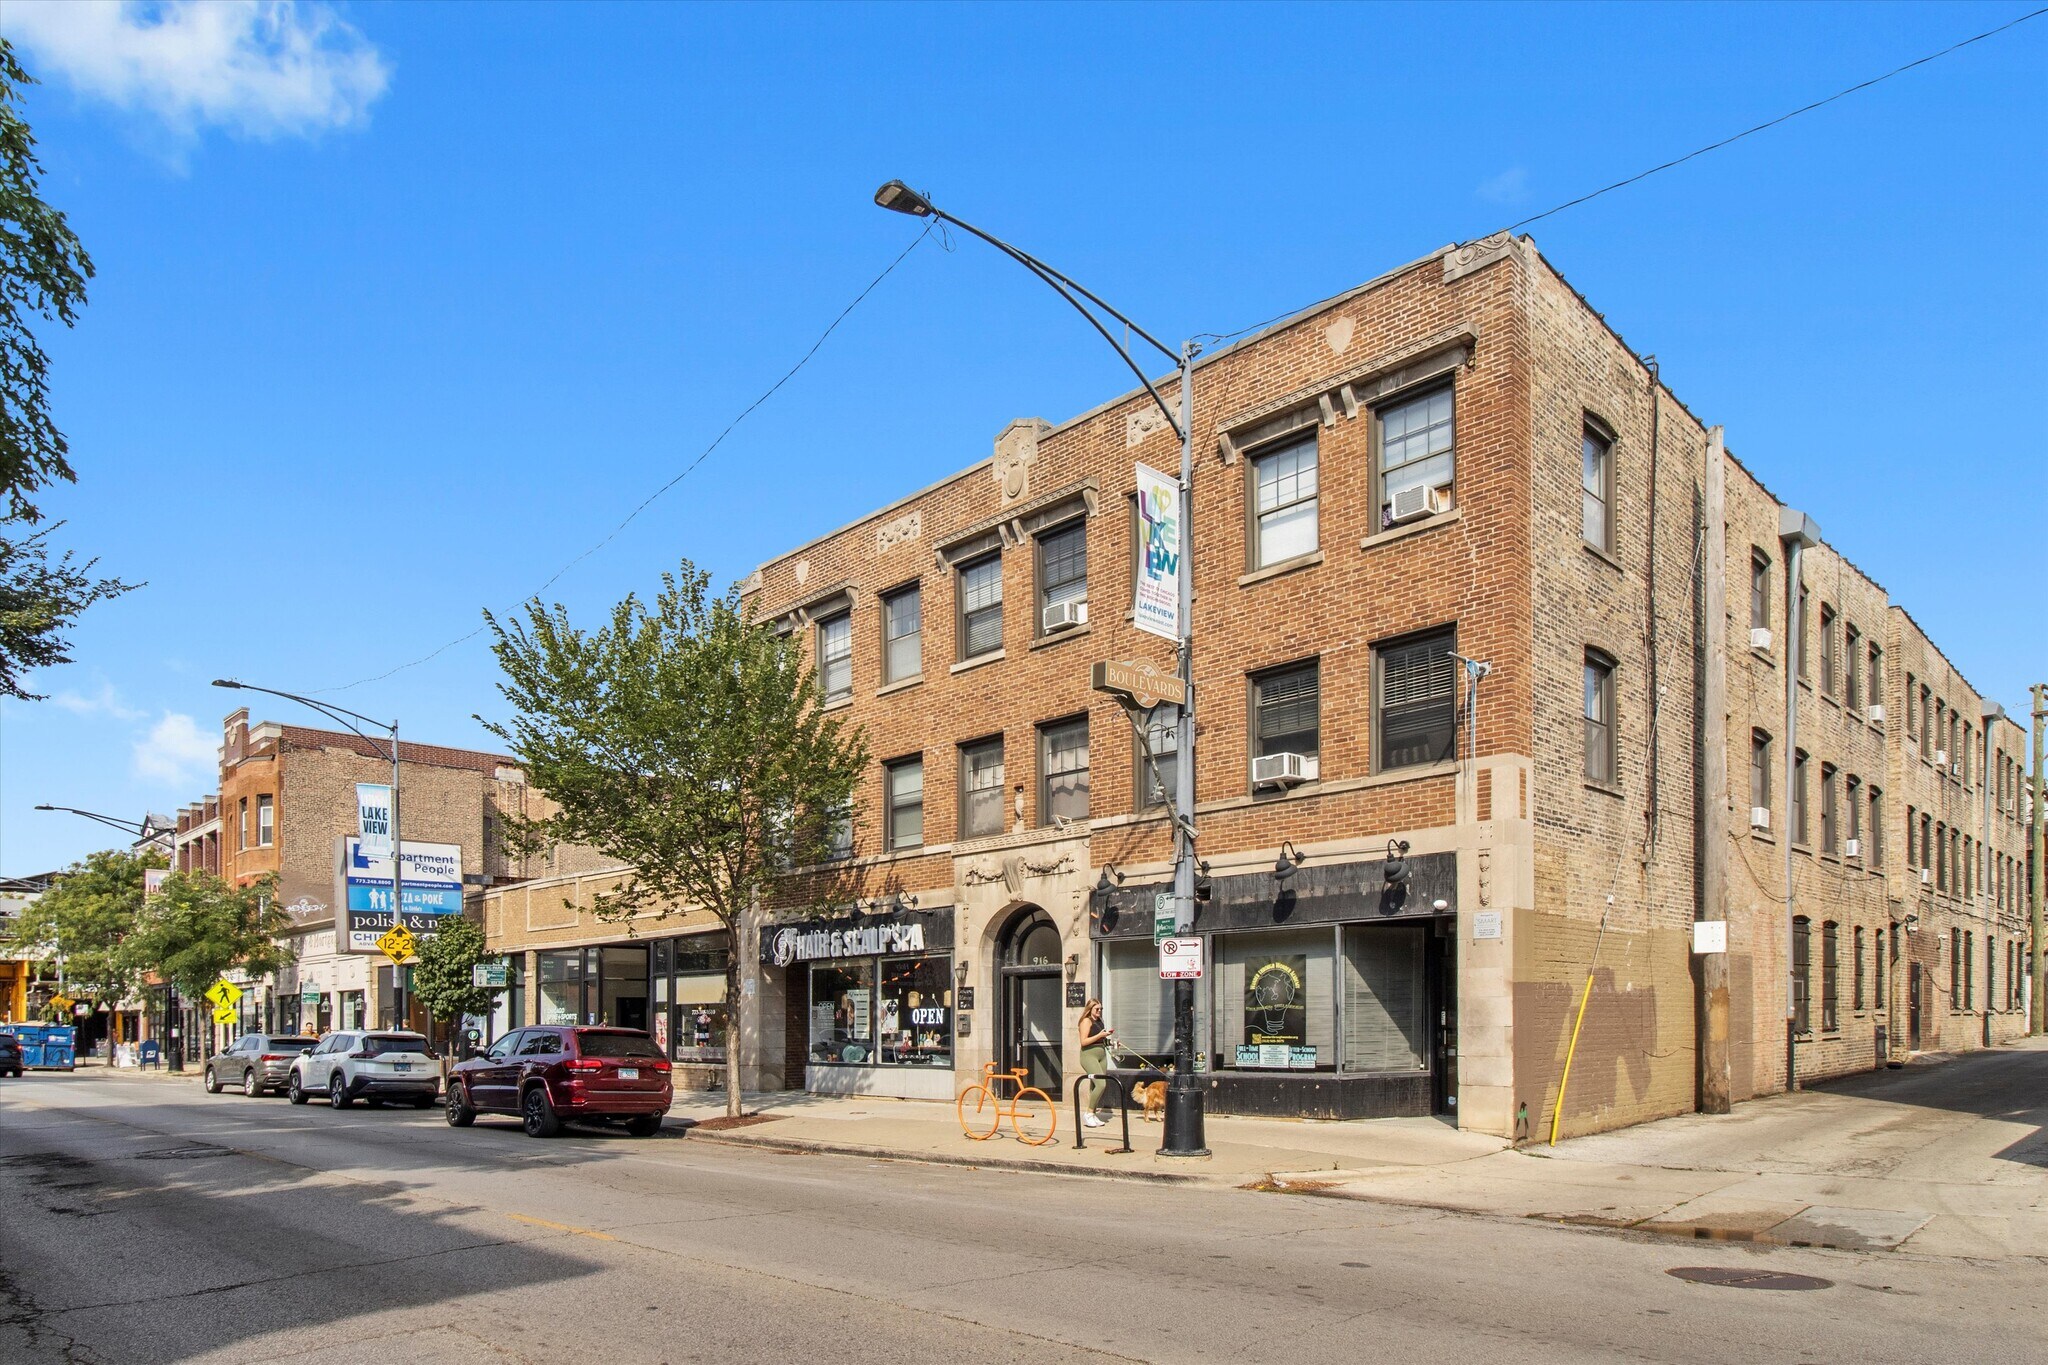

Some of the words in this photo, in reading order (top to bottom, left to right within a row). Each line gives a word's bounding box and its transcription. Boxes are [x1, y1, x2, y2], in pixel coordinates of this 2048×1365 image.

[1138, 600, 1175, 619] LAKEVIEW
[1109, 668, 1182, 699] BOULEVARDS
[362, 806, 388, 821] LAKE
[363, 820, 388, 835] VIEW
[414, 863, 455, 876] People
[390, 891, 413, 904] PZA
[414, 894, 421, 902] &
[422, 891, 444, 905] POKÉ
[410, 914, 425, 929] &
[796, 931, 831, 960] HAIR
[830, 930, 844, 958] &
[842, 927, 890, 957] SCALP
[892, 923, 925, 953] SPA
[1032, 956, 1049, 965] 916
[912, 1008, 945, 1025] OPEN
[1236, 1051, 1259, 1061] SCHOOL
[1289, 1053, 1317, 1061] PROGRAM
